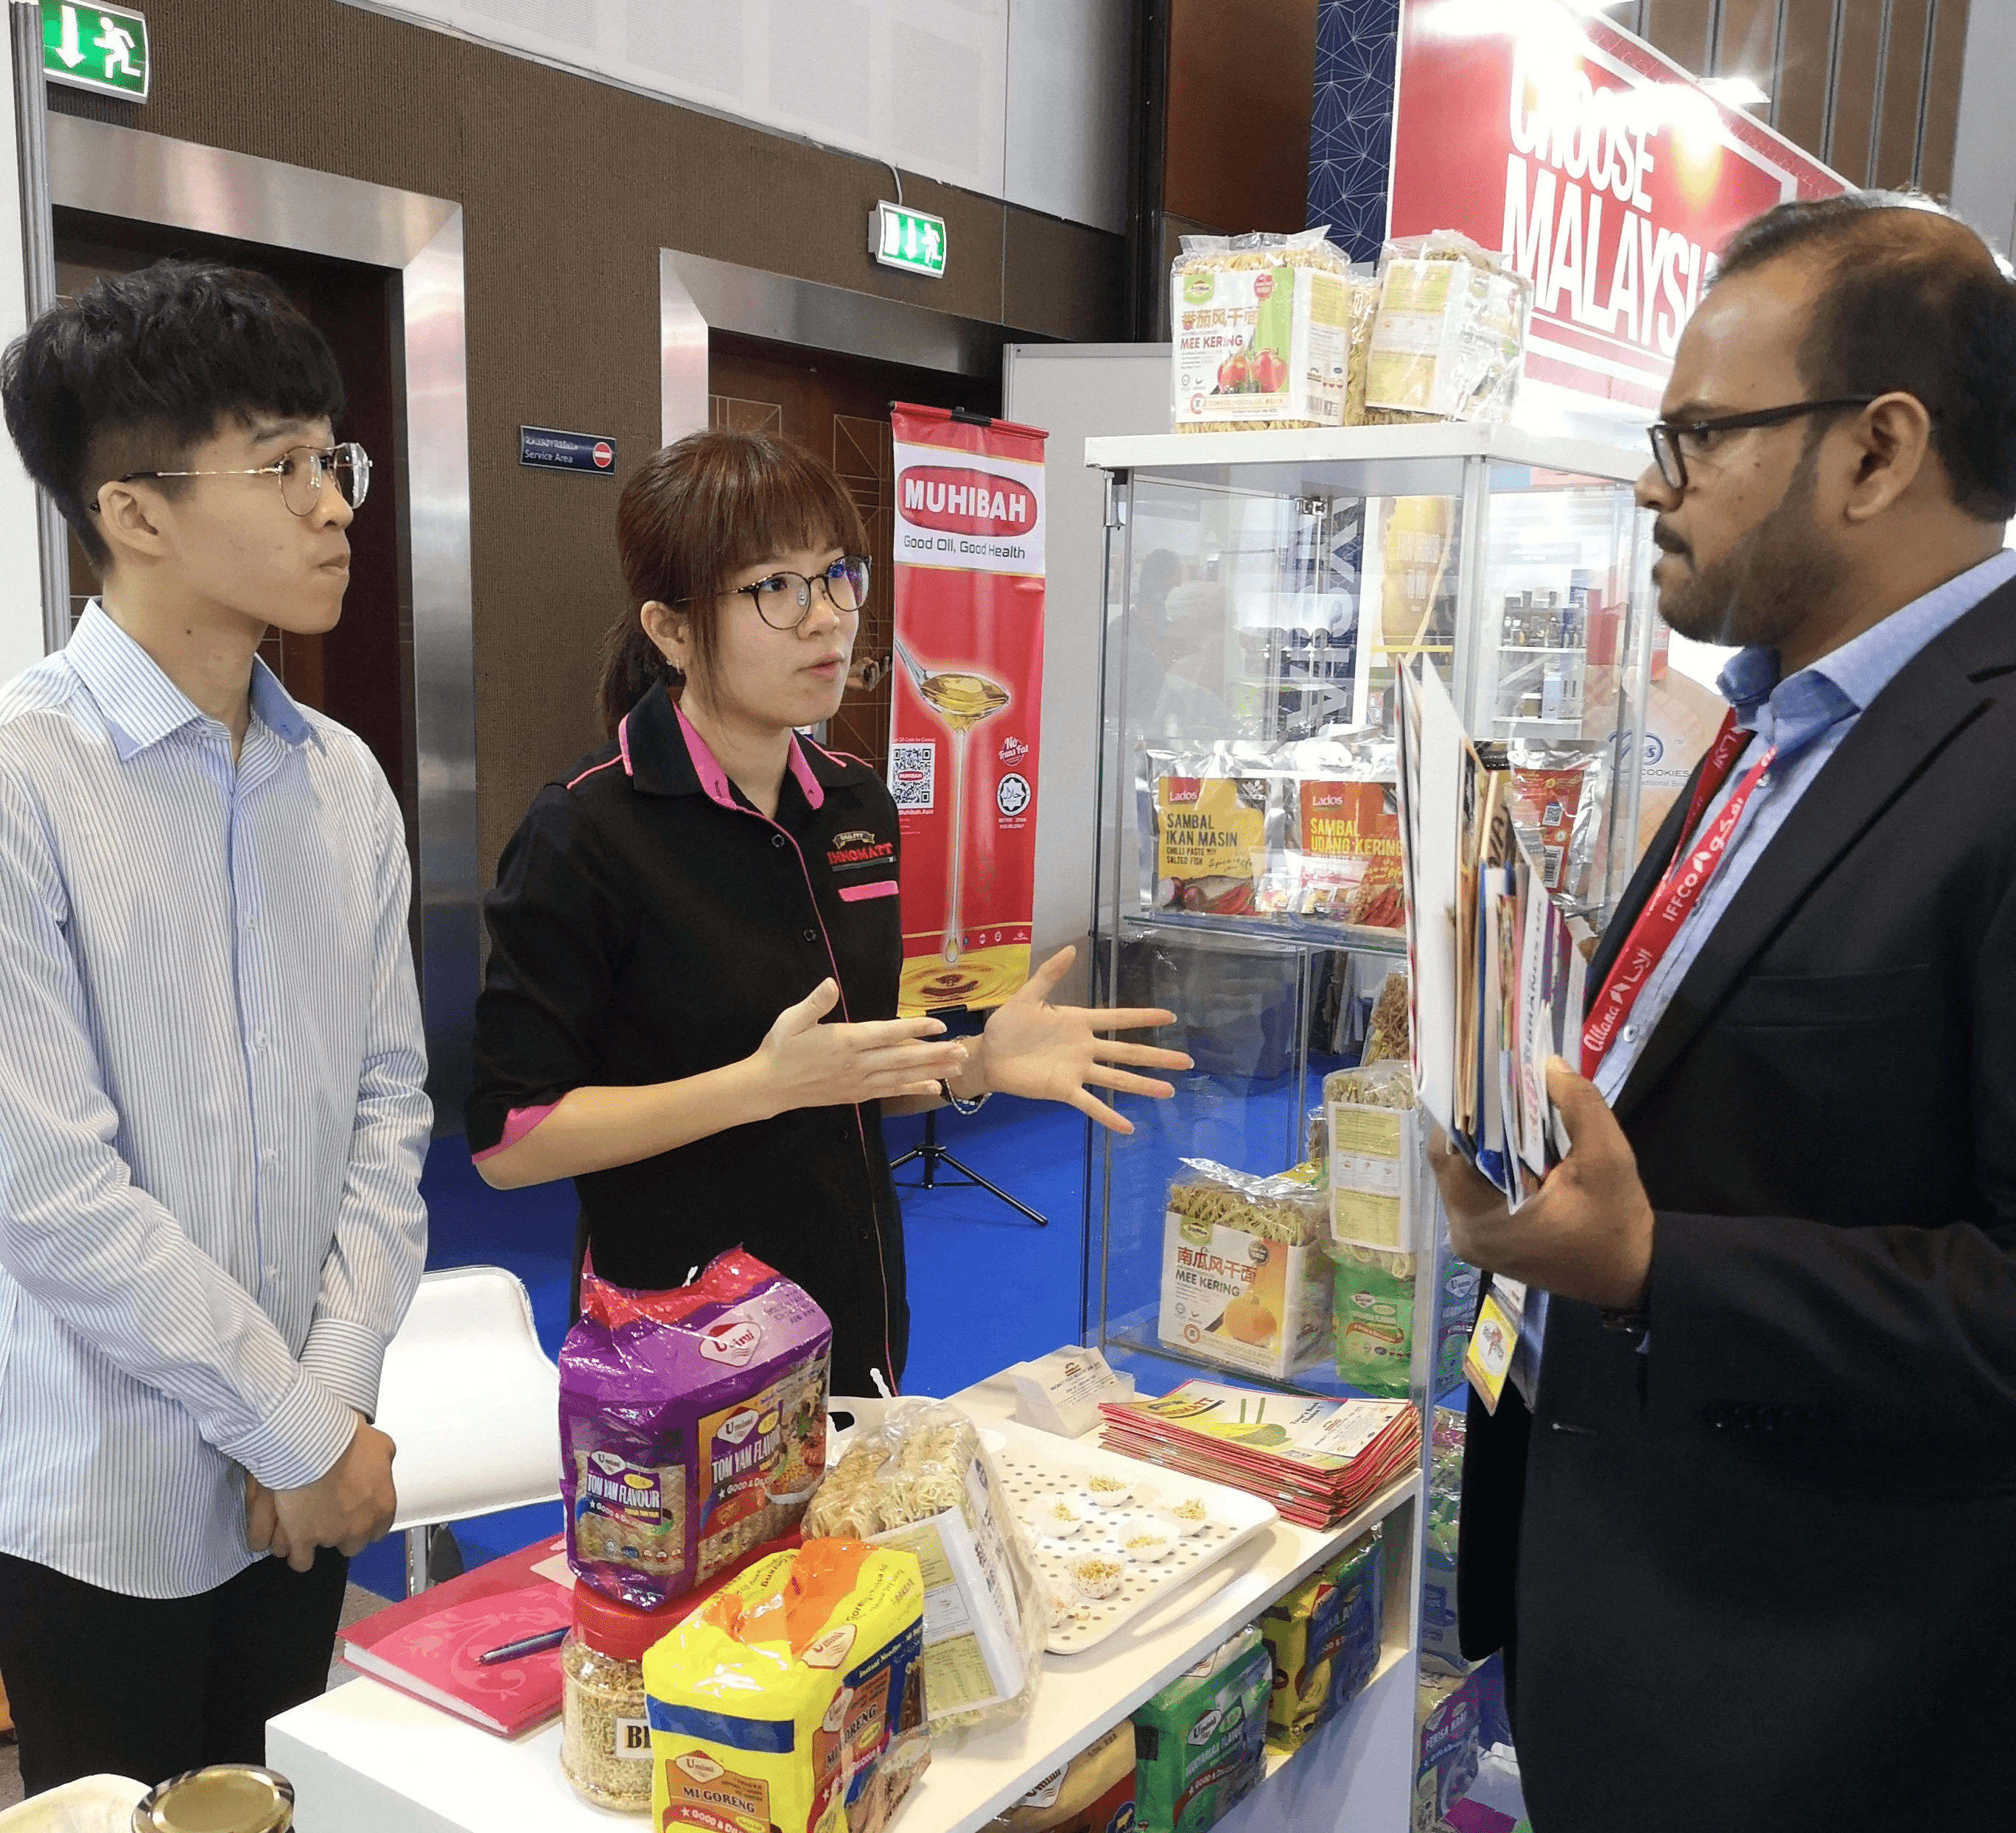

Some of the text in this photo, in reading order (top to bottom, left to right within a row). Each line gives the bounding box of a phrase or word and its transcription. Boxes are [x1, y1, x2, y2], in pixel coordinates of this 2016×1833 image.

[1508, 33, 1659, 213] CHOOSE
[1180, 334, 1243, 349] MEE KERING
[525, 449, 573, 463] Service Area
[905, 478, 1026, 523] MUHIBAH
[903, 535, 1026, 559] Good Oil, Good Health
[1004, 735, 1018, 750] No
[1016, 744, 1029, 754] Fat
[1169, 790, 1199, 802] Lados
[1312, 794, 1343, 806] Lados
[1167, 813, 1214, 830] SAMBAL
[1310, 817, 1360, 837] SAMBAL
[1166, 830, 1238, 847] IKAN MASIN
[1311, 835, 1402, 856] UDANG KERING
[826, 841, 893, 865] INNOMATT
[1166, 847, 1185, 855] CHILLI
[1186, 847, 1205, 856] PASTE
[1166, 856, 1203, 865] SALTED FISH
[1662, 873, 1699, 922] IFFCO
[1177, 1246, 1258, 1285] 南瓜风干面
[1175, 1269, 1197, 1285] MEE
[1200, 1276, 1241, 1297] KERING
[726, 1416, 753, 1435] Umimi
[598, 1453, 620, 1468] Umimi
[712, 1455, 733, 1485] TOM
[735, 1444, 752, 1473] YAM
[587, 1473, 660, 1508] TOM YAM FLAVOUR
[858, 1658, 881, 1678] Instant
[686, 1758, 714, 1773] Umimi
[682, 1786, 700, 1798] MI
[703, 1790, 755, 1814] GORENG
